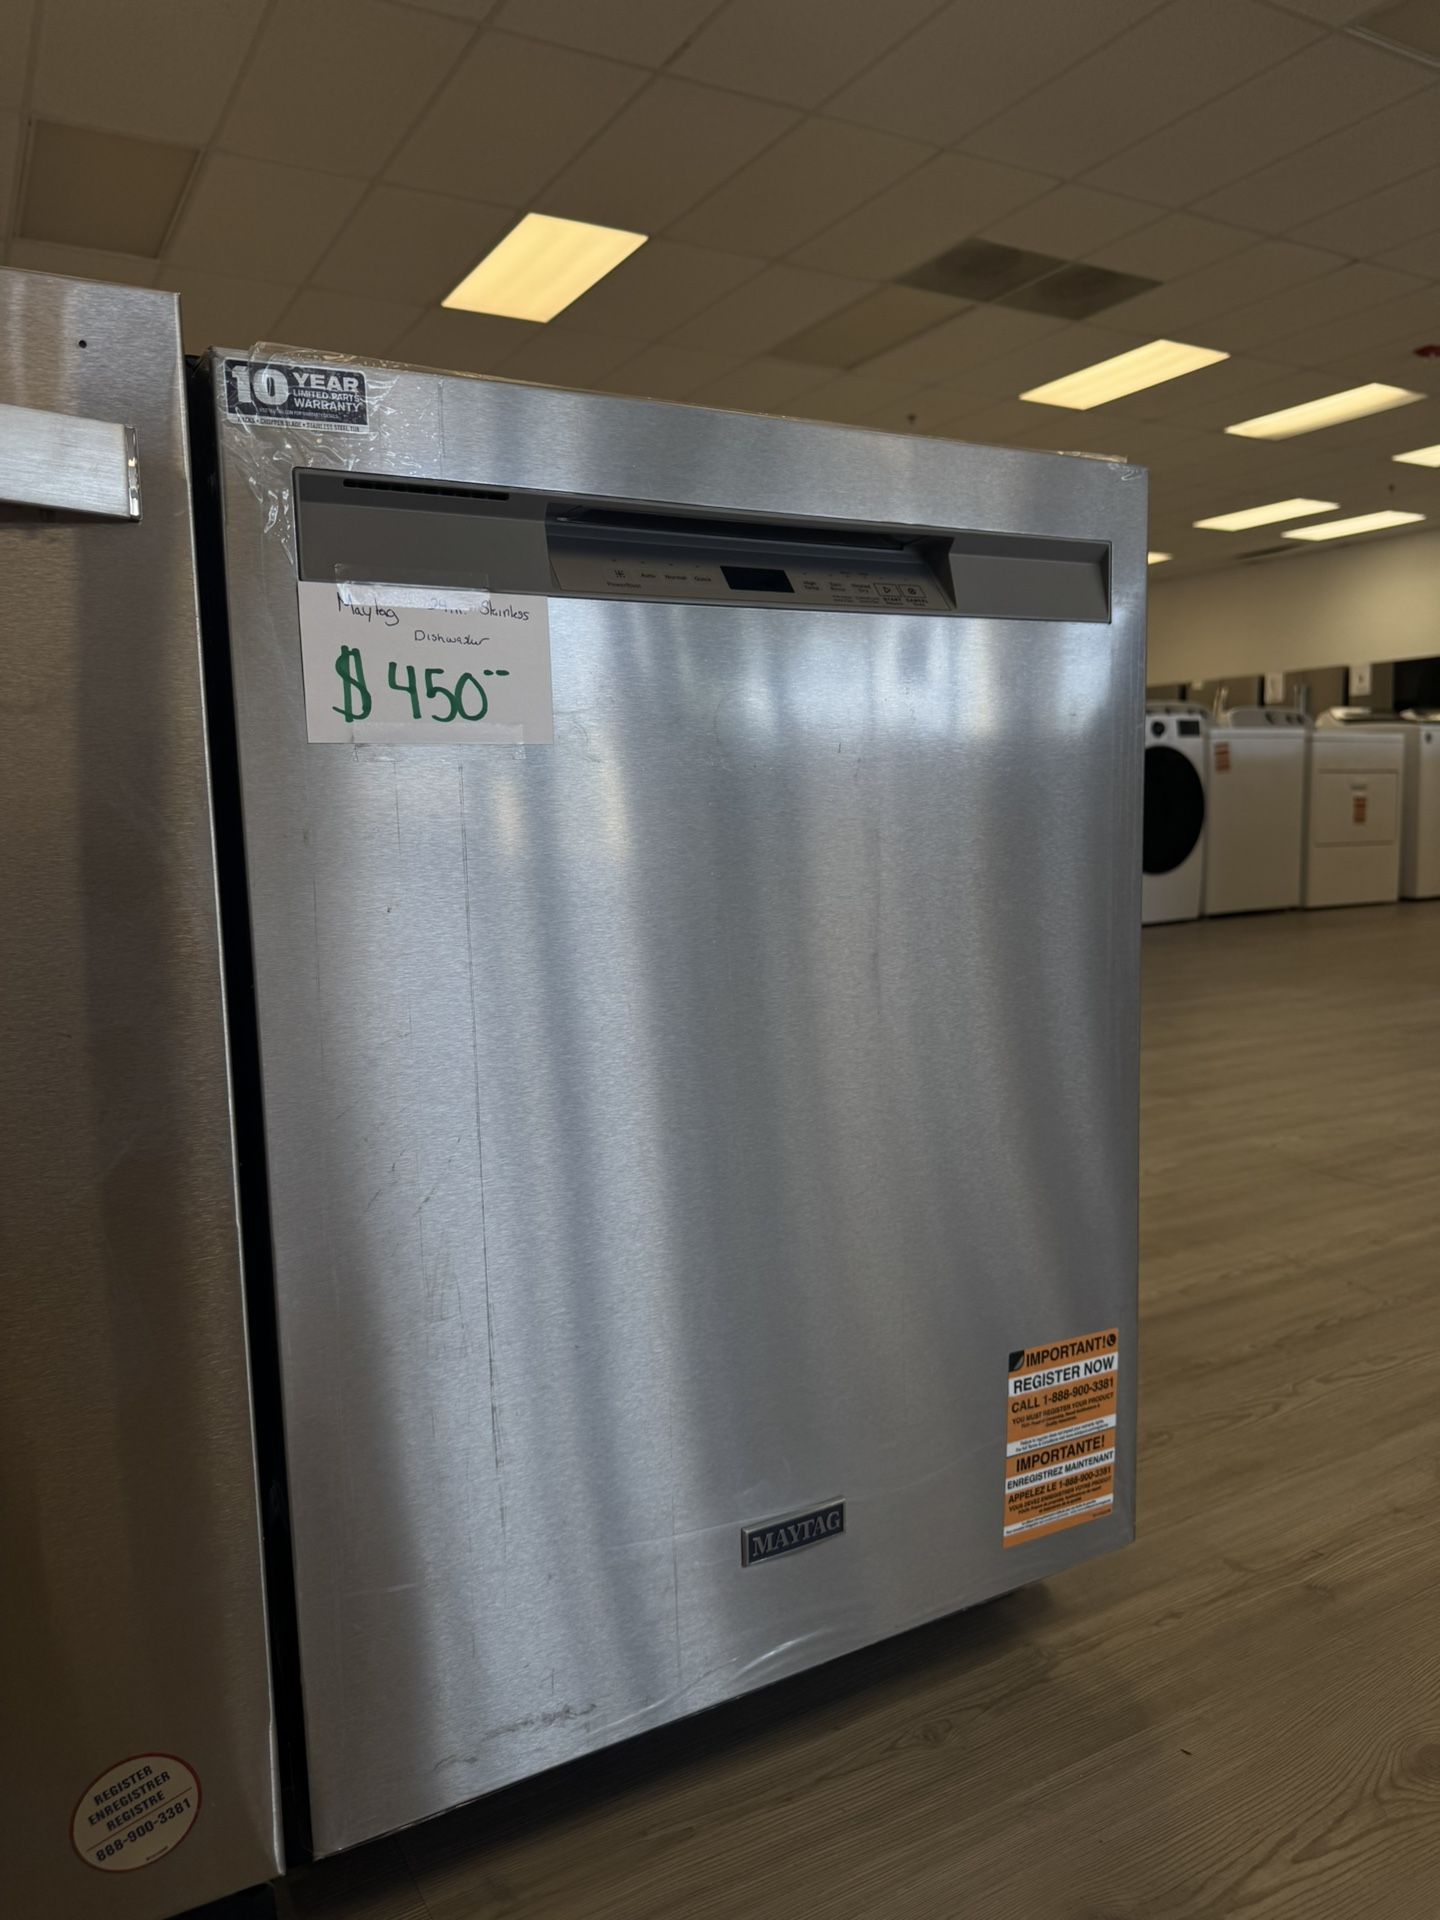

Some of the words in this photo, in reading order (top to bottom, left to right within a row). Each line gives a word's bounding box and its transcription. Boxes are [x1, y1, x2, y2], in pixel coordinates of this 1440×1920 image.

[232, 366, 290, 406] 10
[293, 372, 359, 393] YEAR
[293, 389, 328, 400] LIMITED
[331, 392, 361, 402] PARTS
[294, 398, 361, 413] WARRANTY
[337, 591, 400, 627] Maytag
[479, 600, 530, 621] Stainless
[1026, 1336, 1106, 1367] IMPORTANT!
[1013, 1365, 1080, 1394] REGISTER
[1084, 1356, 1115, 1376] NOW
[1011, 1397, 1040, 1413] CALL
[1044, 1377, 1114, 1405] 1-888-900-3381
[1007, 1466, 1063, 1489] ENREGISTREZ
[1065, 1451, 1114, 1473] MAINTENANT
[1016, 1435, 1105, 1472] IMPORTANTE!
[1008, 1487, 1045, 1504] APPELEZ
[1046, 1482, 1057, 1493] LE
[752, 1510, 840, 1557] MAYTAG
[87, 1770, 171, 1826] ENREGISTRER
[93, 1765, 153, 1806] REGISTER
[106, 1790, 166, 1831] REGISTRE
[95, 1798, 191, 1862] 888-900-3381
